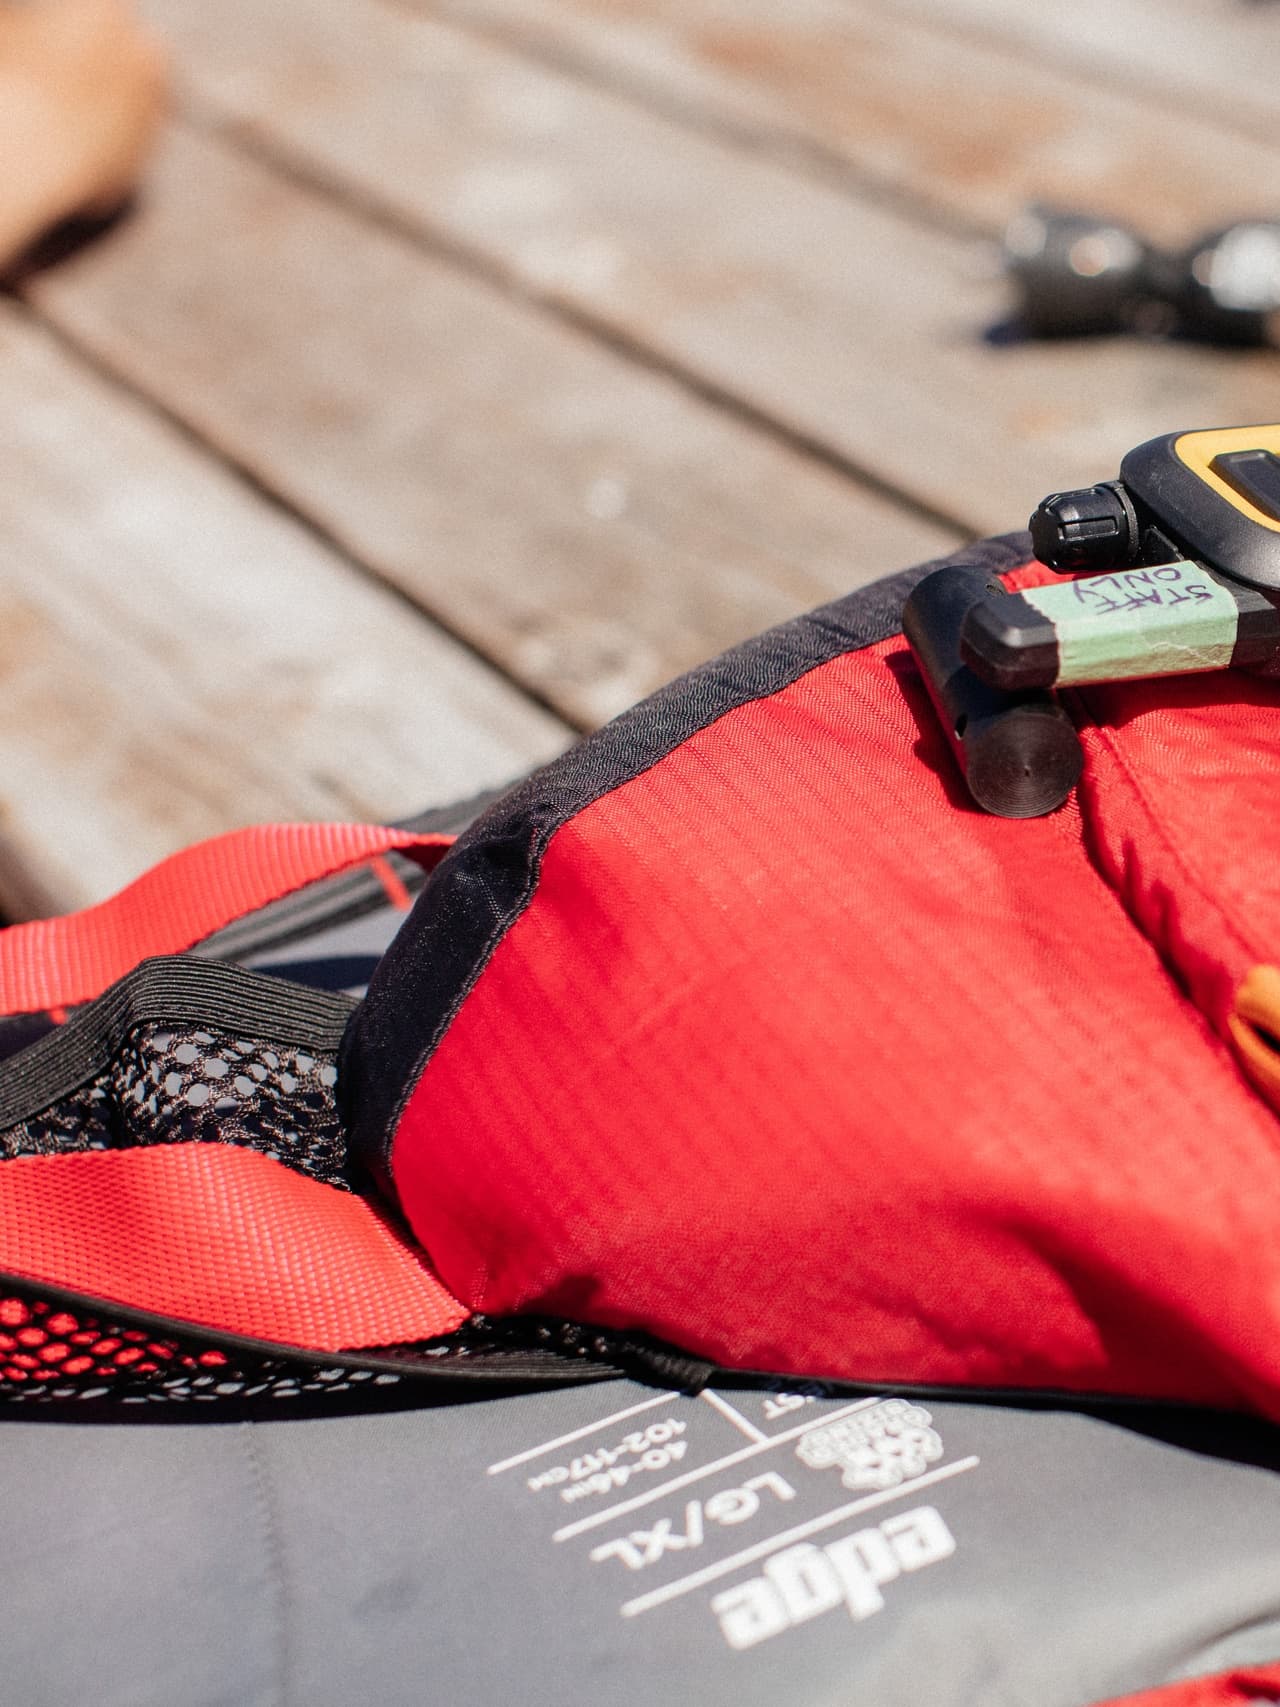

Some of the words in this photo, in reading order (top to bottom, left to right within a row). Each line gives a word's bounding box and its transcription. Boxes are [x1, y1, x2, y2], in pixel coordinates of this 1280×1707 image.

[1072, 567, 1182, 604] ONLY
[1096, 584, 1214, 616] STAFF
[589, 1471, 797, 1571] LG/XL
[711, 1505, 957, 1651] edge
